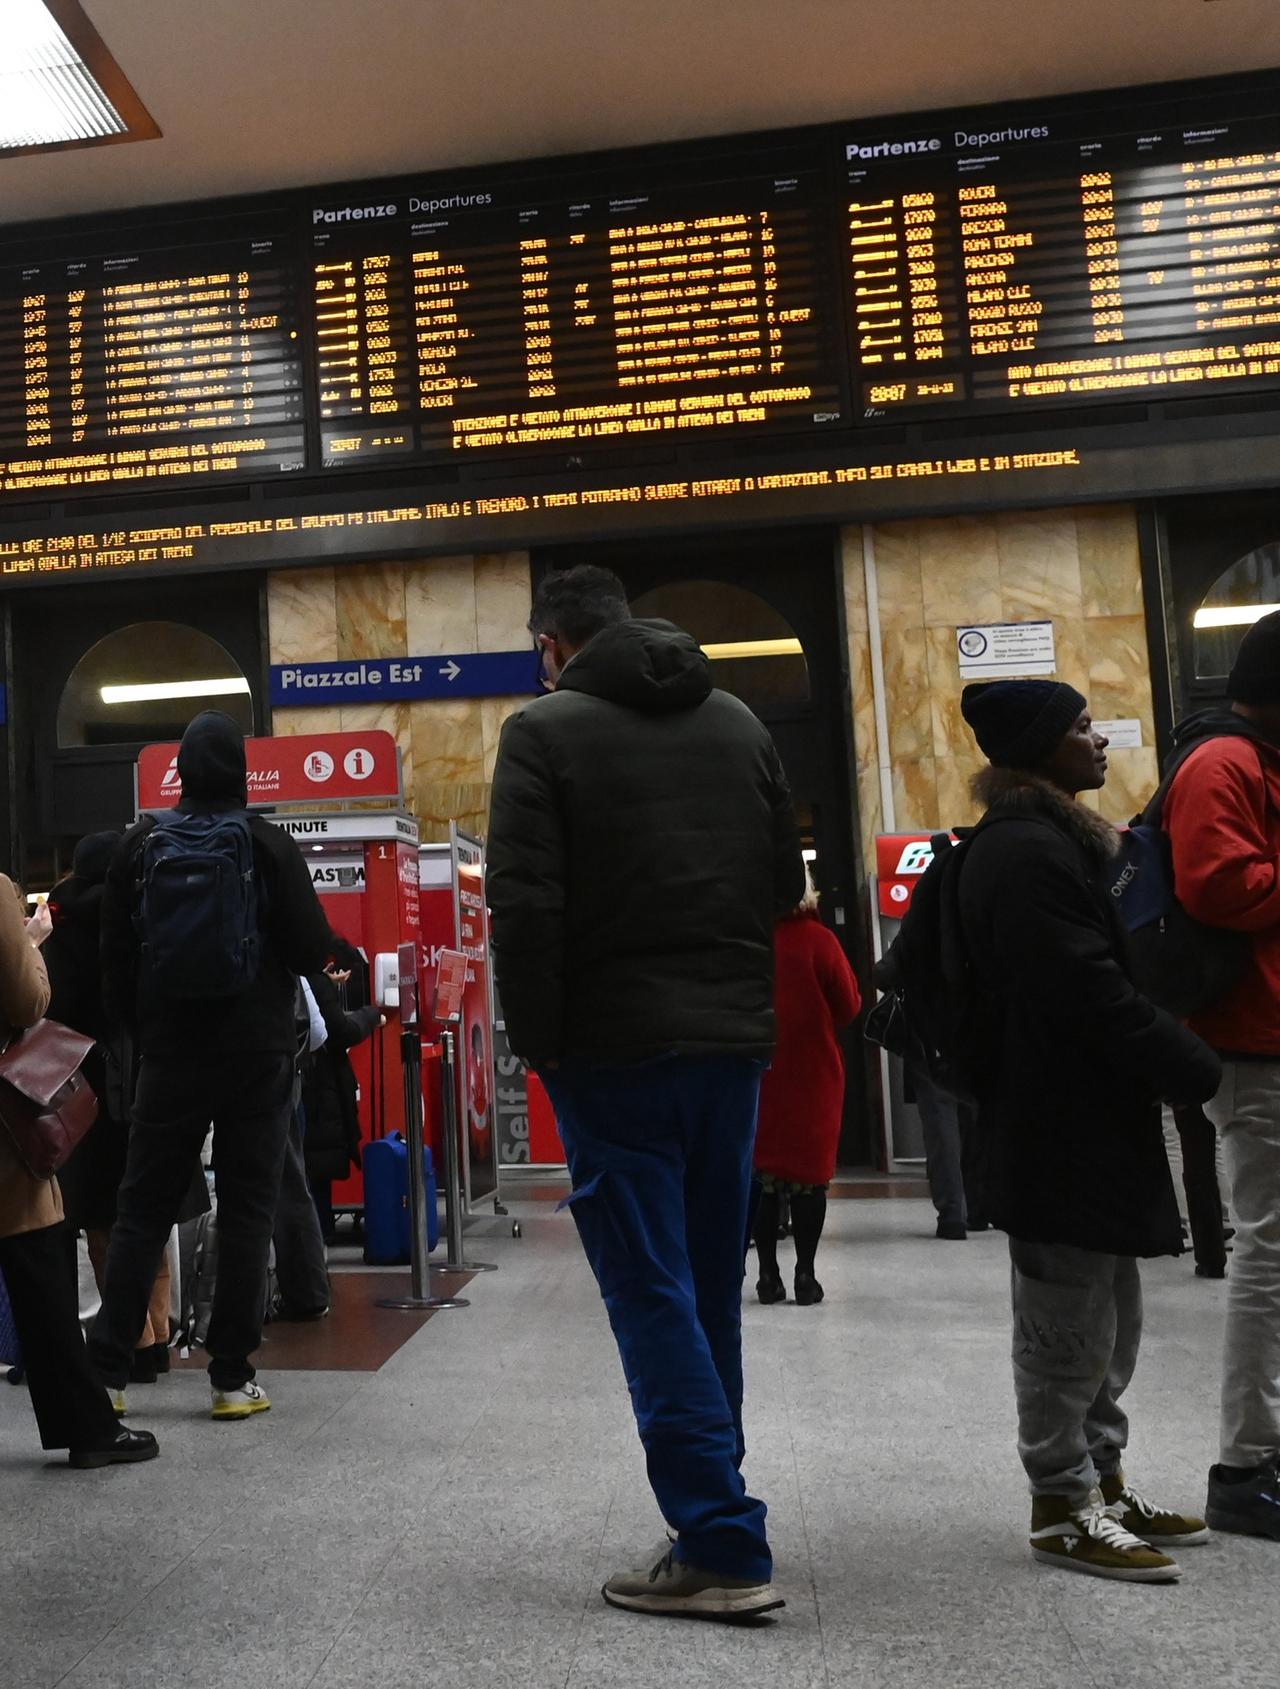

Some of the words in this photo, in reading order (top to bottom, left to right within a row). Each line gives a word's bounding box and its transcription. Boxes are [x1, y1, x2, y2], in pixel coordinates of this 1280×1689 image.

[846, 138, 941, 160] Partenze
[954, 126, 1049, 147] Departures
[313, 203, 397, 224] Partenze
[409, 193, 492, 213] Departures
[281, 665, 381, 689] Piazzale
[390, 664, 422, 683] Est
[378, 846, 387, 859] 1
[1111, 861, 1139, 897] ONEX
